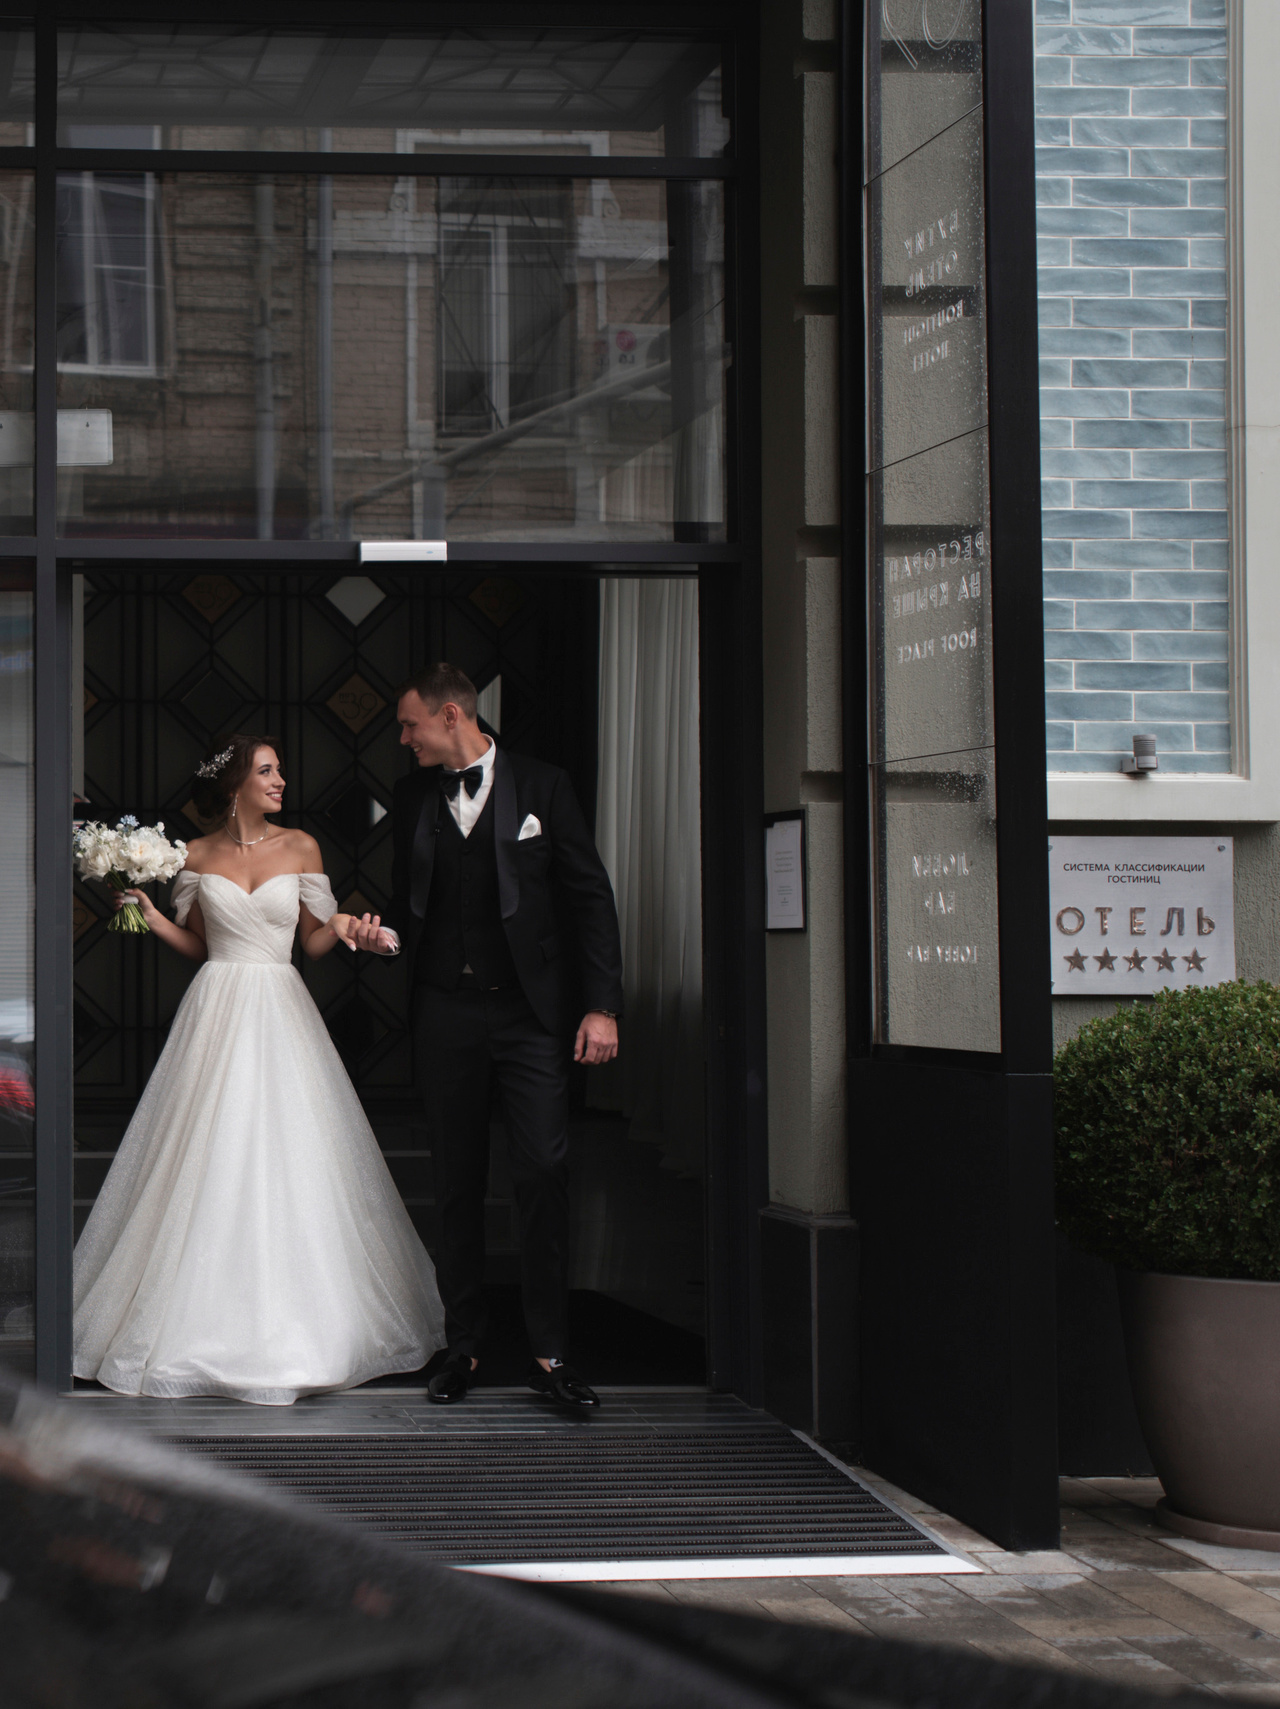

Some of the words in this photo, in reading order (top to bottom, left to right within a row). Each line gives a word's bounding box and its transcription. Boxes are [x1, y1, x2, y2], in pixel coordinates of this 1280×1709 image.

[1063, 863, 1110, 872] СИСТЕМА
[1114, 863, 1205, 873] КЛАССИФИКАЦИИ
[1107, 875, 1161, 885] ГОСТИНИЦ
[1056, 906, 1216, 937] ОТЕЛЬ
